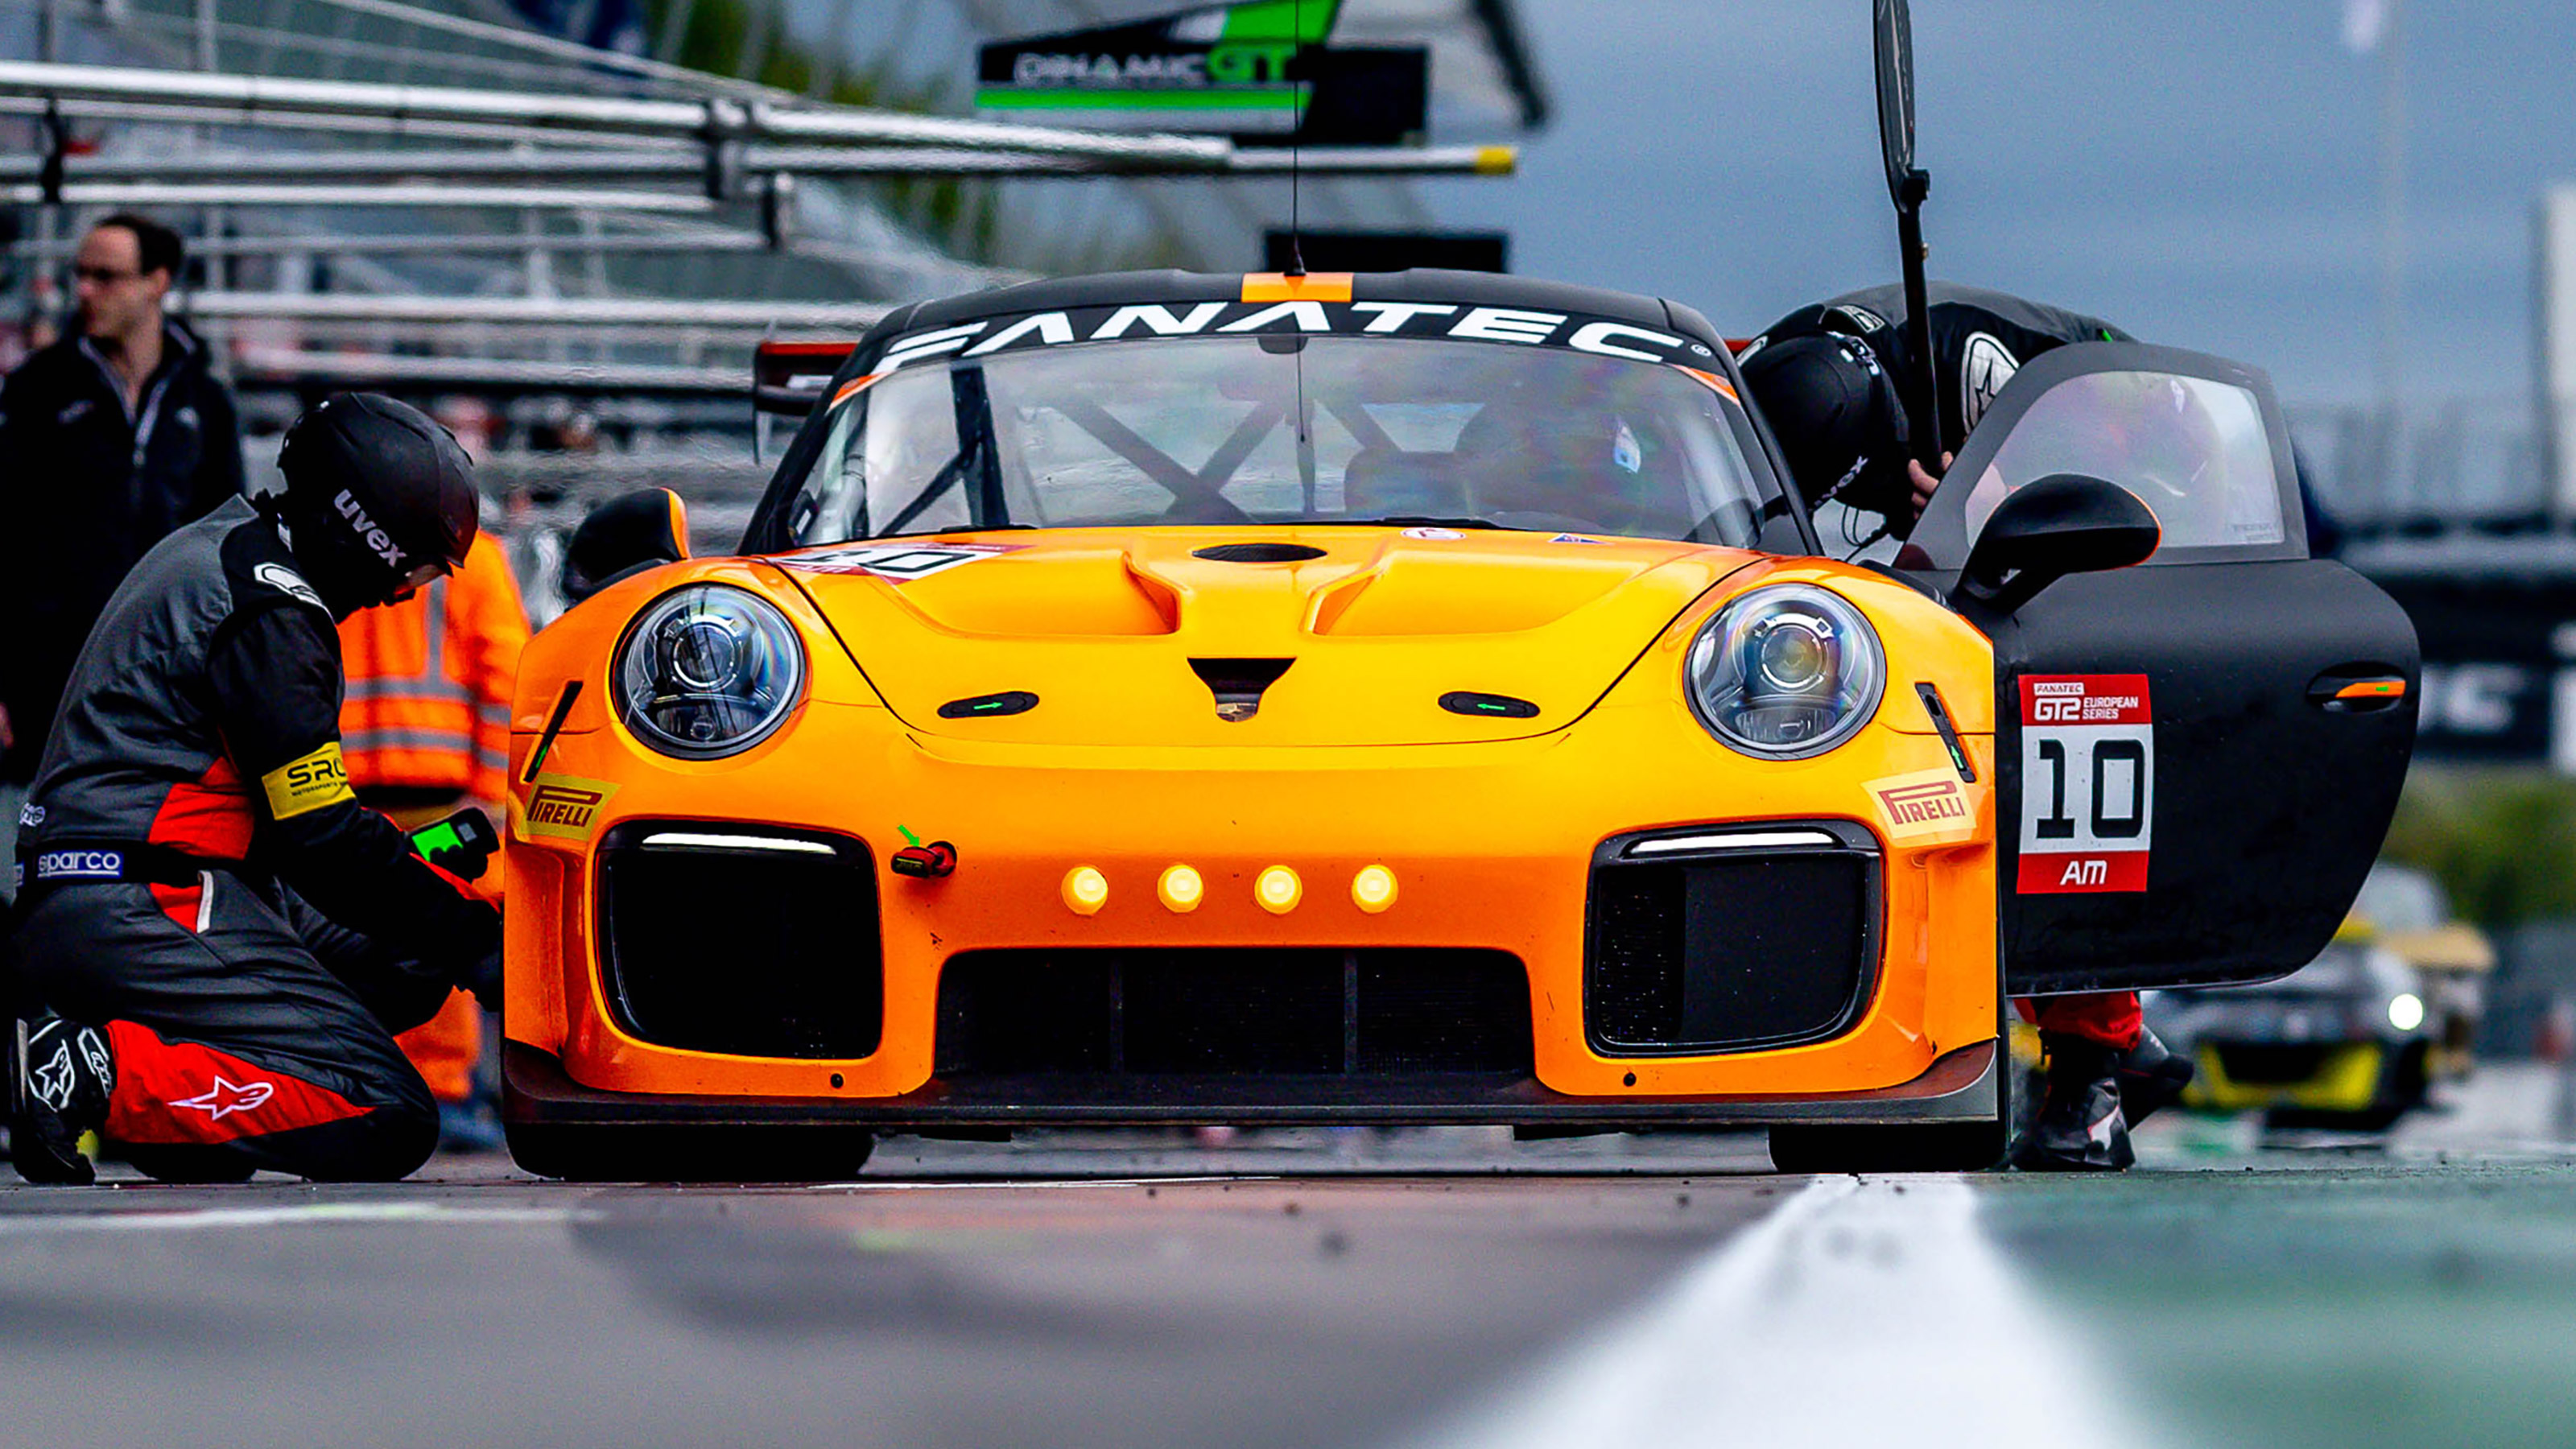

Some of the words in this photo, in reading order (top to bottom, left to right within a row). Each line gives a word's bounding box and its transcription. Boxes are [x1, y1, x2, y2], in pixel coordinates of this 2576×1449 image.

[334, 489, 407, 568] uvex
[2037, 684, 2083, 693] FANATEC
[2034, 697, 2082, 720] GT2
[2083, 696, 2139, 708] EUROPEAN
[2083, 708, 2119, 720] SERIES
[2036, 739, 2145, 839] 10
[526, 784, 603, 828] PIRELLI
[1877, 780, 1966, 825] PIRELLI
[39, 852, 121, 875] sparco
[2059, 860, 2107, 886] AM
